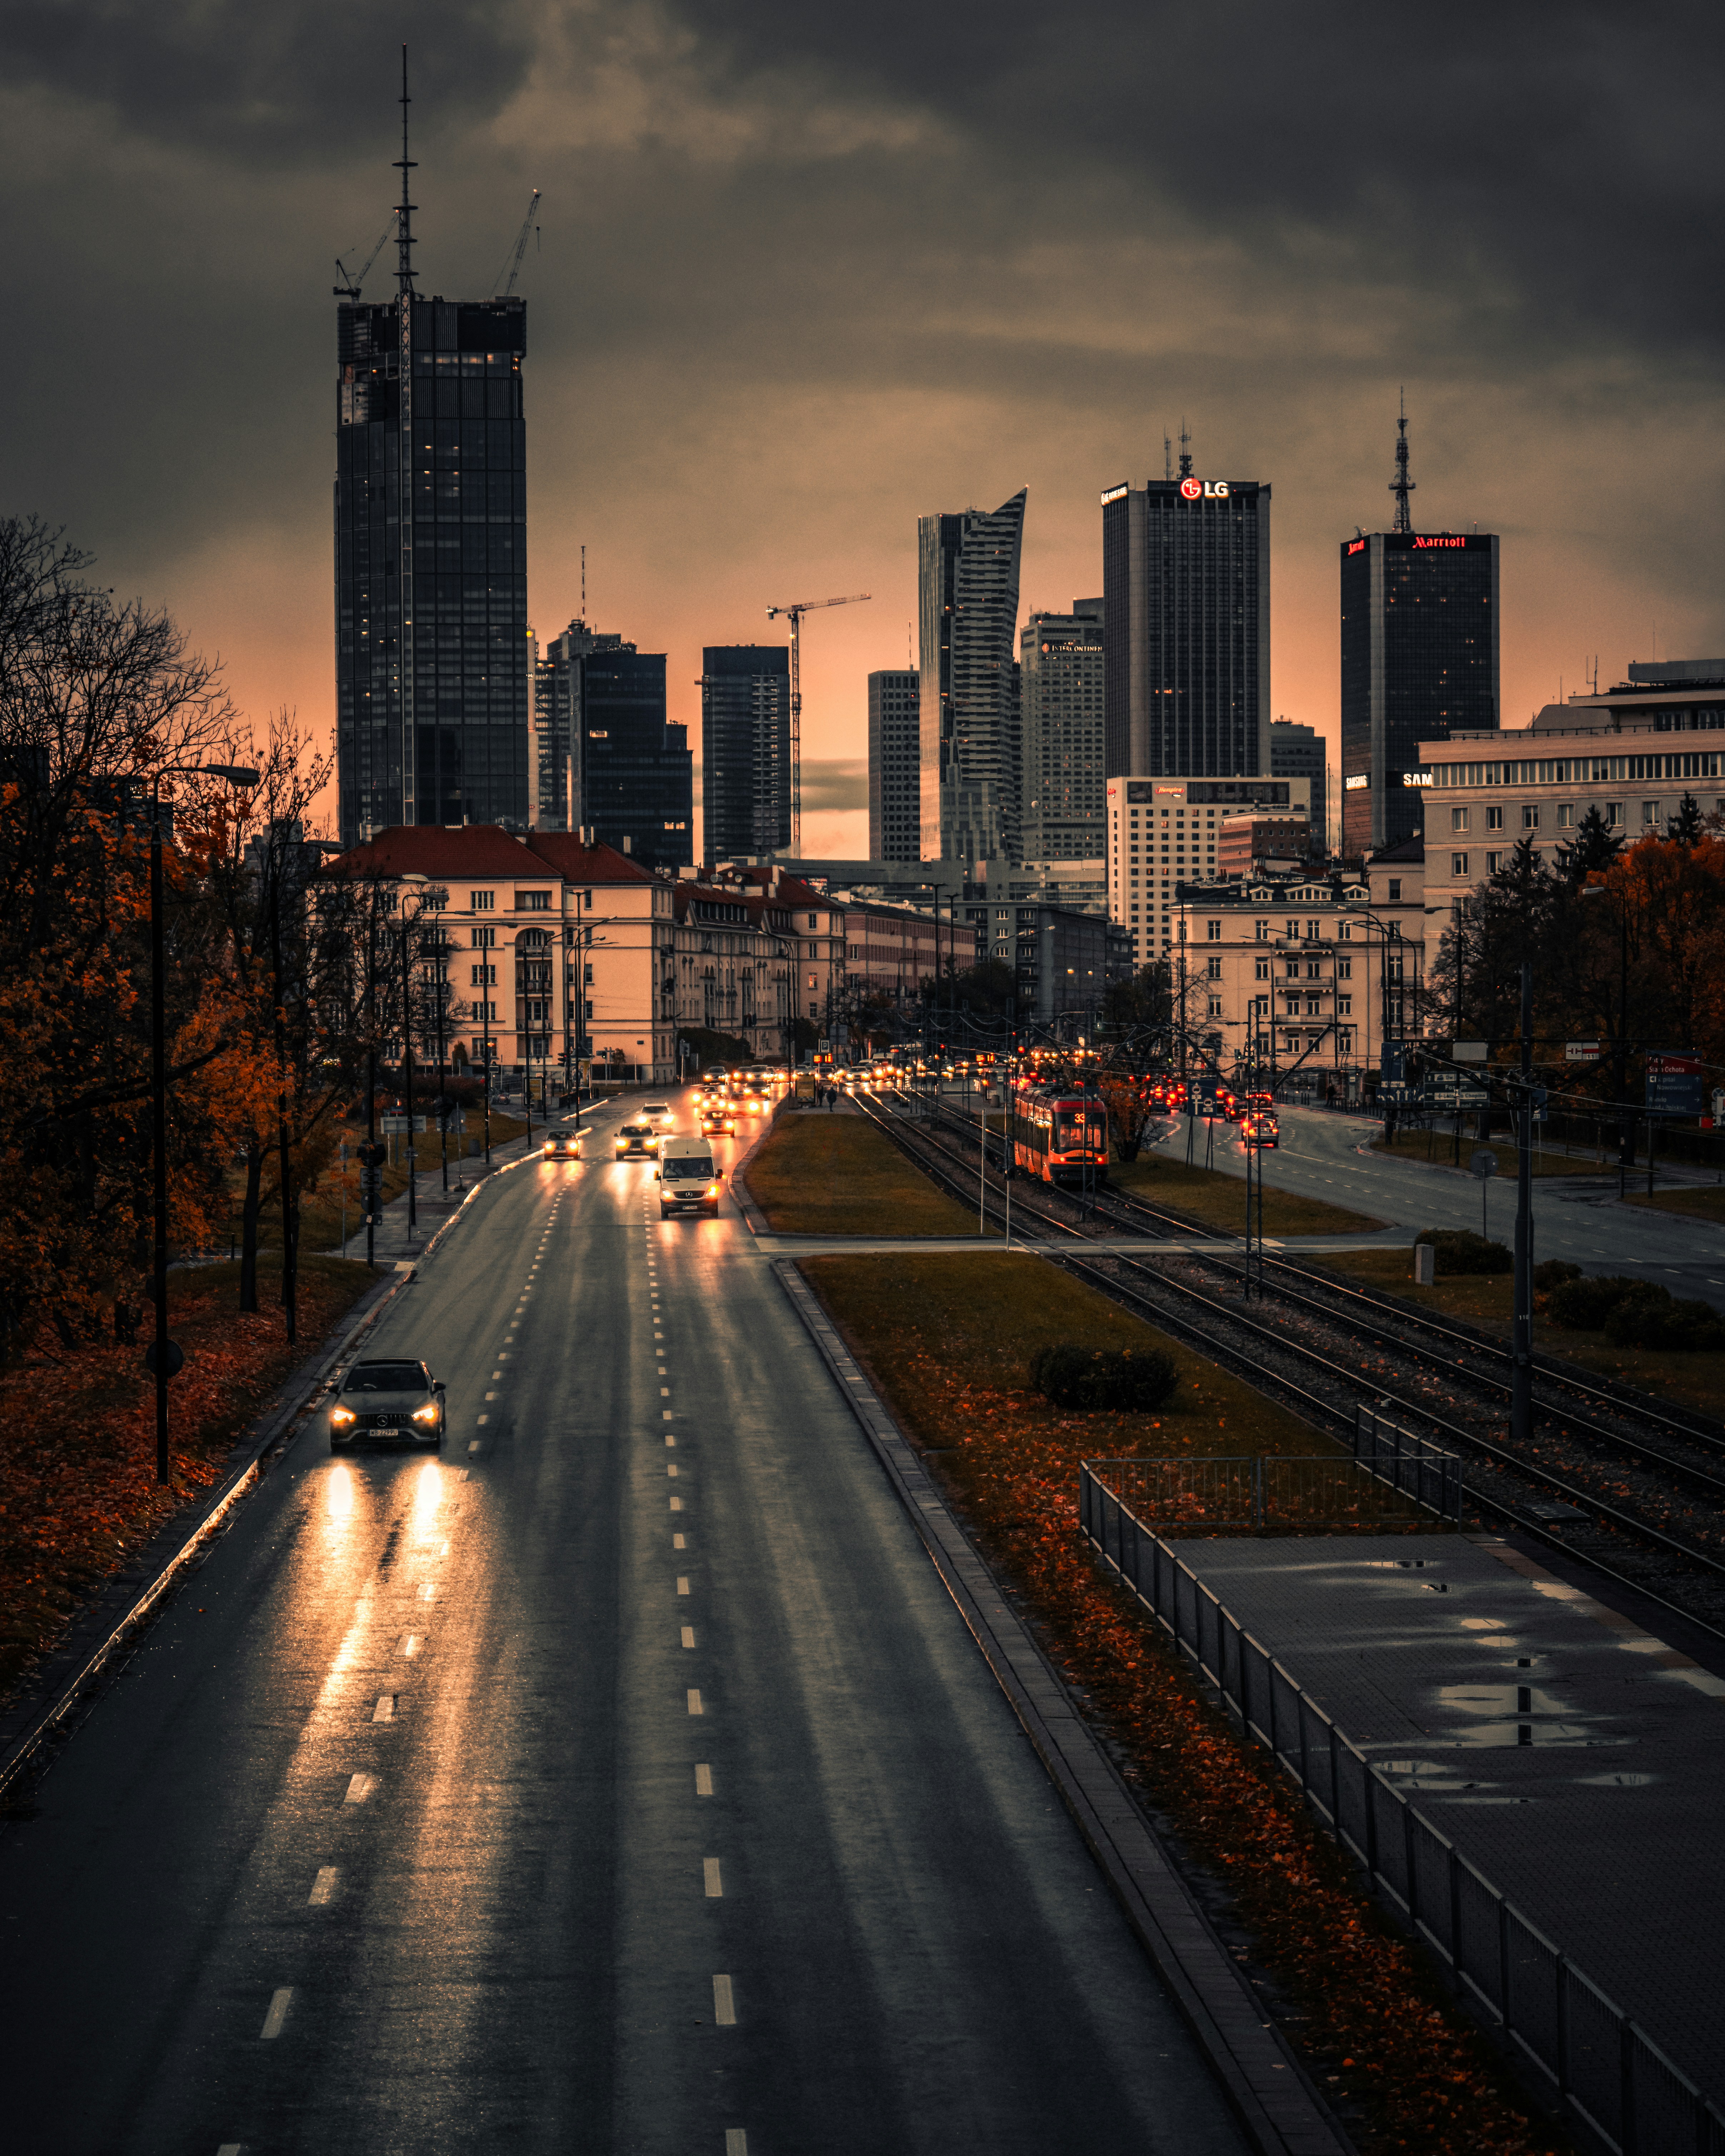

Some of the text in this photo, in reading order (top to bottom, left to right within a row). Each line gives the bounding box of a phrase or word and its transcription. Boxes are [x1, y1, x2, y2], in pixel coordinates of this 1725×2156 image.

[1204, 482, 1228, 497] LG
[1412, 537, 1465, 548] Marriott
[1074, 1113, 1085, 1123] 33
